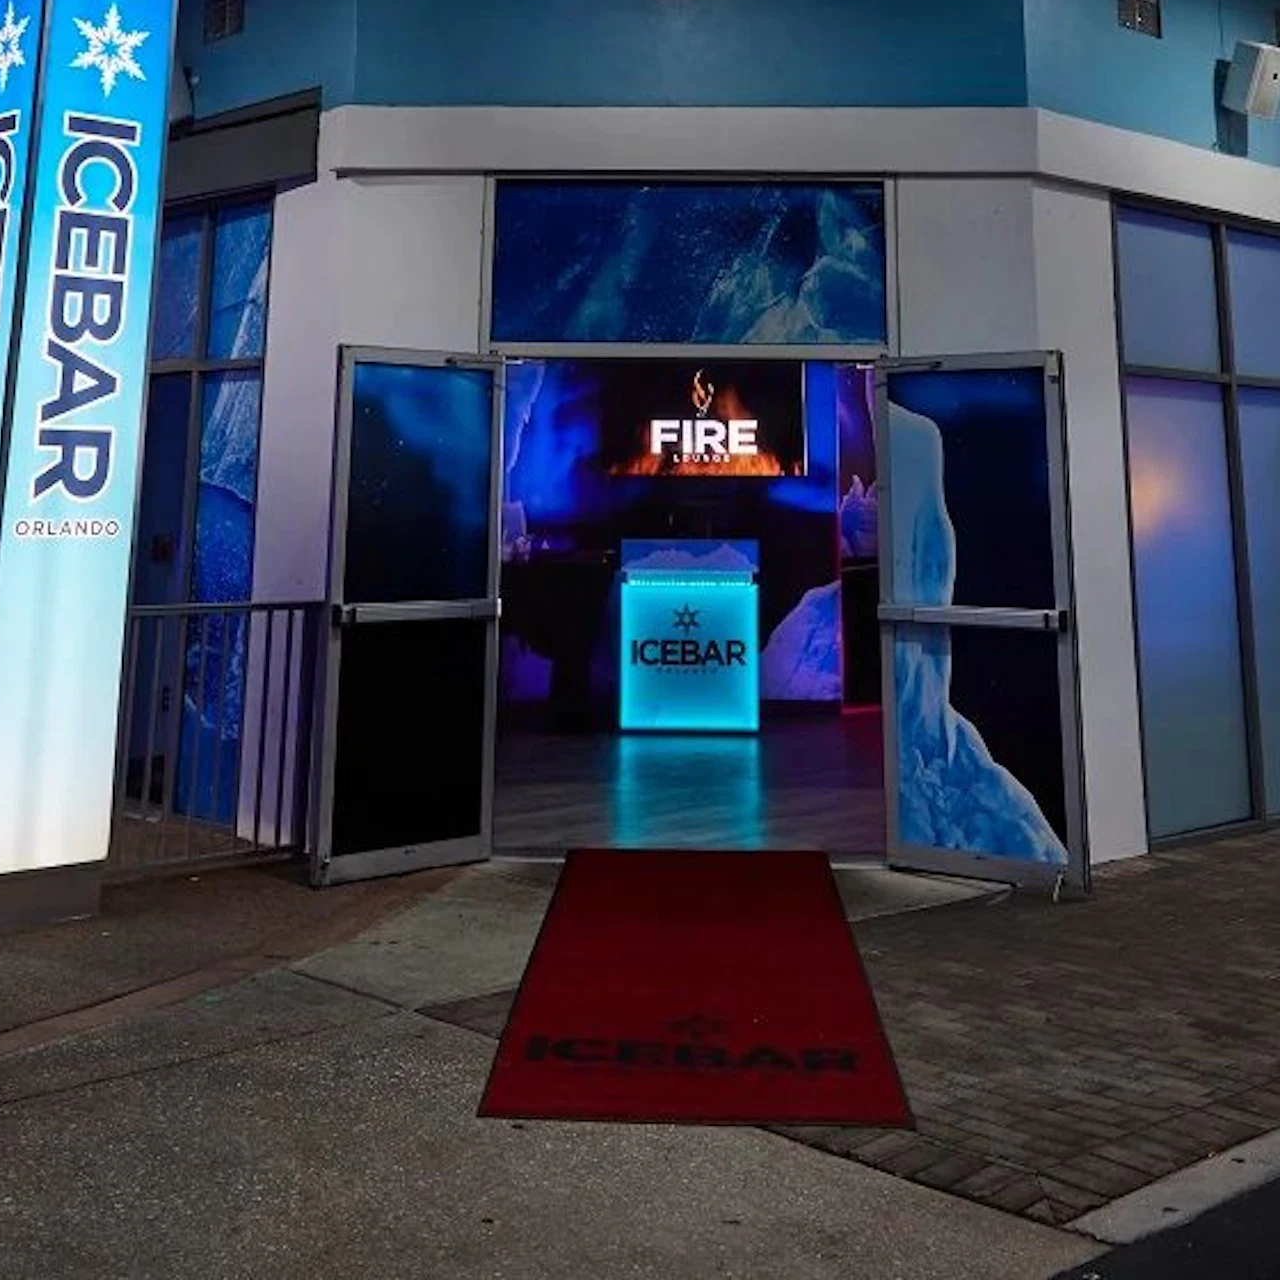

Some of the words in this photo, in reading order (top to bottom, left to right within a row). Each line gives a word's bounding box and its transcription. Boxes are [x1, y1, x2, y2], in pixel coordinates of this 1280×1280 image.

[31, 112, 141, 502] ICEBAR
[650, 419, 759, 454] FIRE
[14, 520, 120, 536] ORLANDO
[631, 639, 747, 666] ICEBAR
[525, 1036, 860, 1073] ICEBAR
